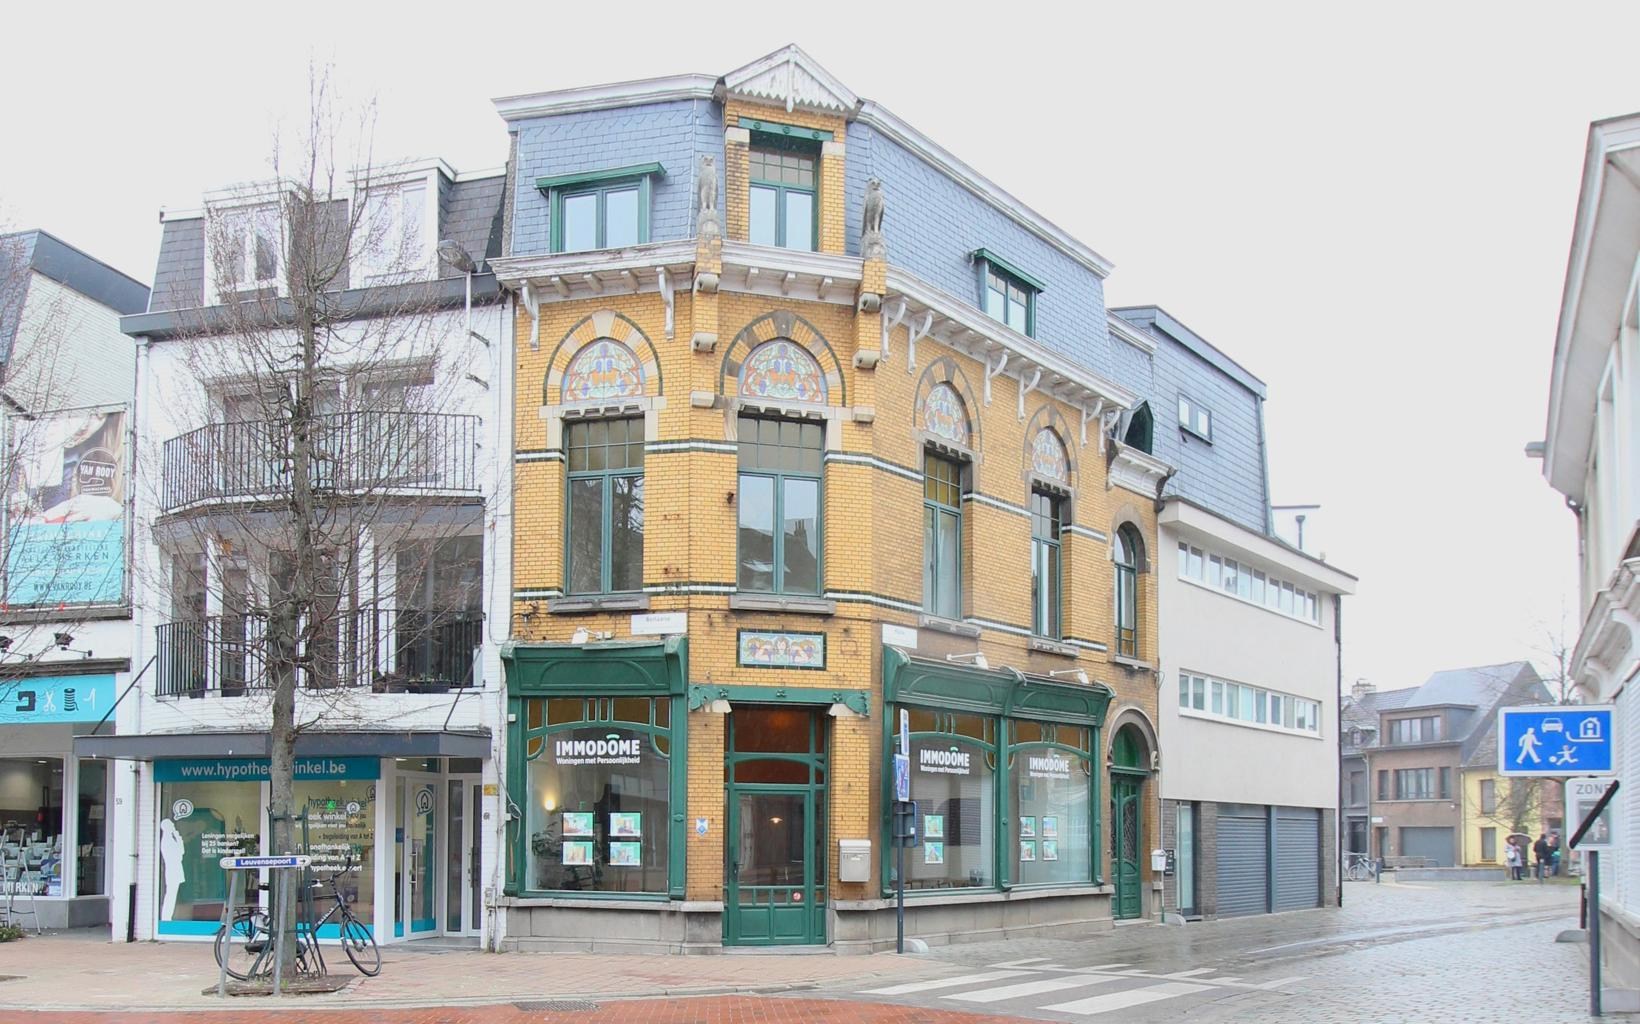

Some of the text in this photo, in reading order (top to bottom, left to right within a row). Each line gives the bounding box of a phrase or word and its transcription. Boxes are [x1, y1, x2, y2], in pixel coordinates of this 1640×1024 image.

[80, 465, 115, 478] VAN ROOY
[556, 757, 585, 765] Woningen
[597, 756, 641, 765] Persoonlijkheid
[181, 760, 347, 778] www.hypotheeinkel.be
[240, 858, 292, 868] Leuvensepoort
